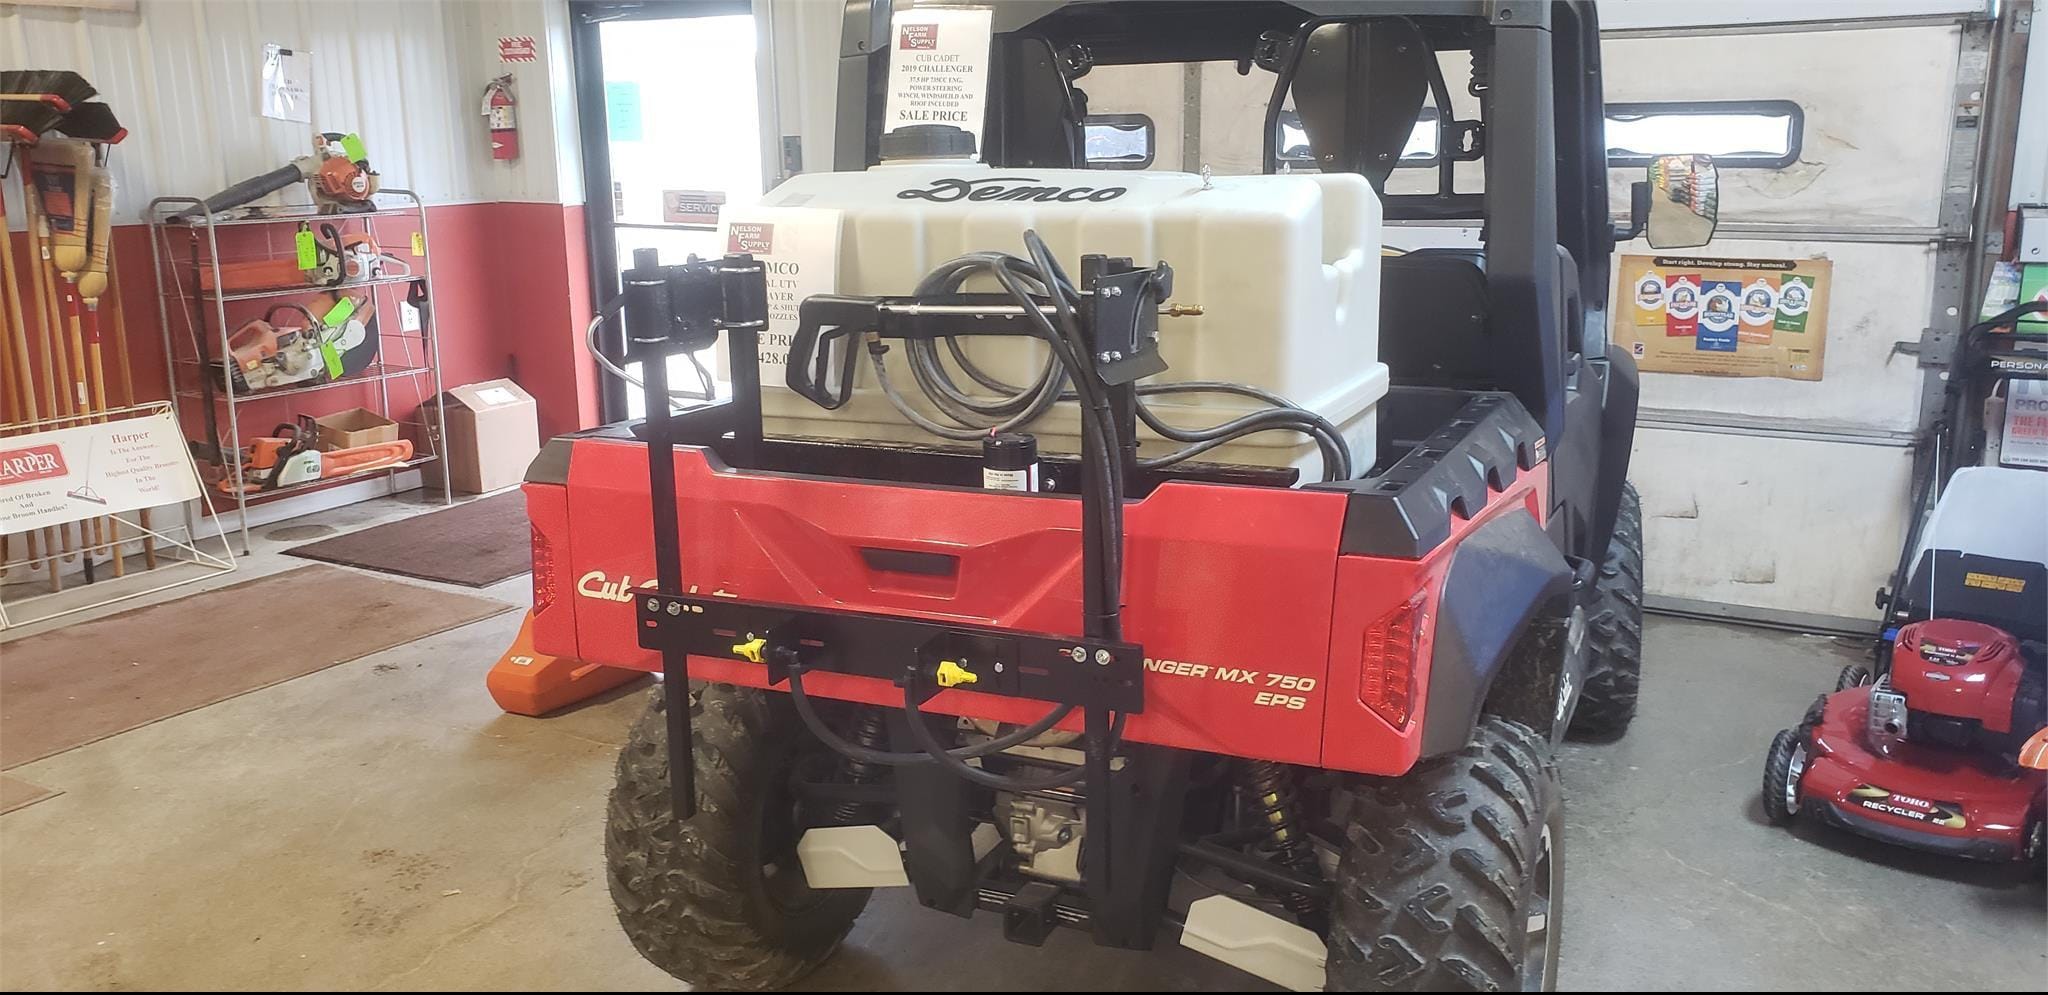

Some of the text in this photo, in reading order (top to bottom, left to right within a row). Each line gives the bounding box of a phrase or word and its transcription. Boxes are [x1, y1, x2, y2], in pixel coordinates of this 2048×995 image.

[915, 54, 960, 62] CUB CADET
[901, 64, 973, 73] 2019 CHALLENGER
[899, 110, 968, 122] SALE PRICE
[896, 177, 1127, 203] Demco
[730, 225, 762, 236] NELSON
[738, 232, 760, 242] FARM
[740, 240, 770, 250] SUPPLY
[111, 431, 150, 443] Harper
[0, 453, 60, 478] ARPER
[1214, 667, 1260, 684] MX
[1265, 673, 1316, 692] 750
[1253, 692, 1307, 710] EPS
[1892, 793, 1930, 808] TORO
[1862, 800, 1926, 820] RECYCLER
